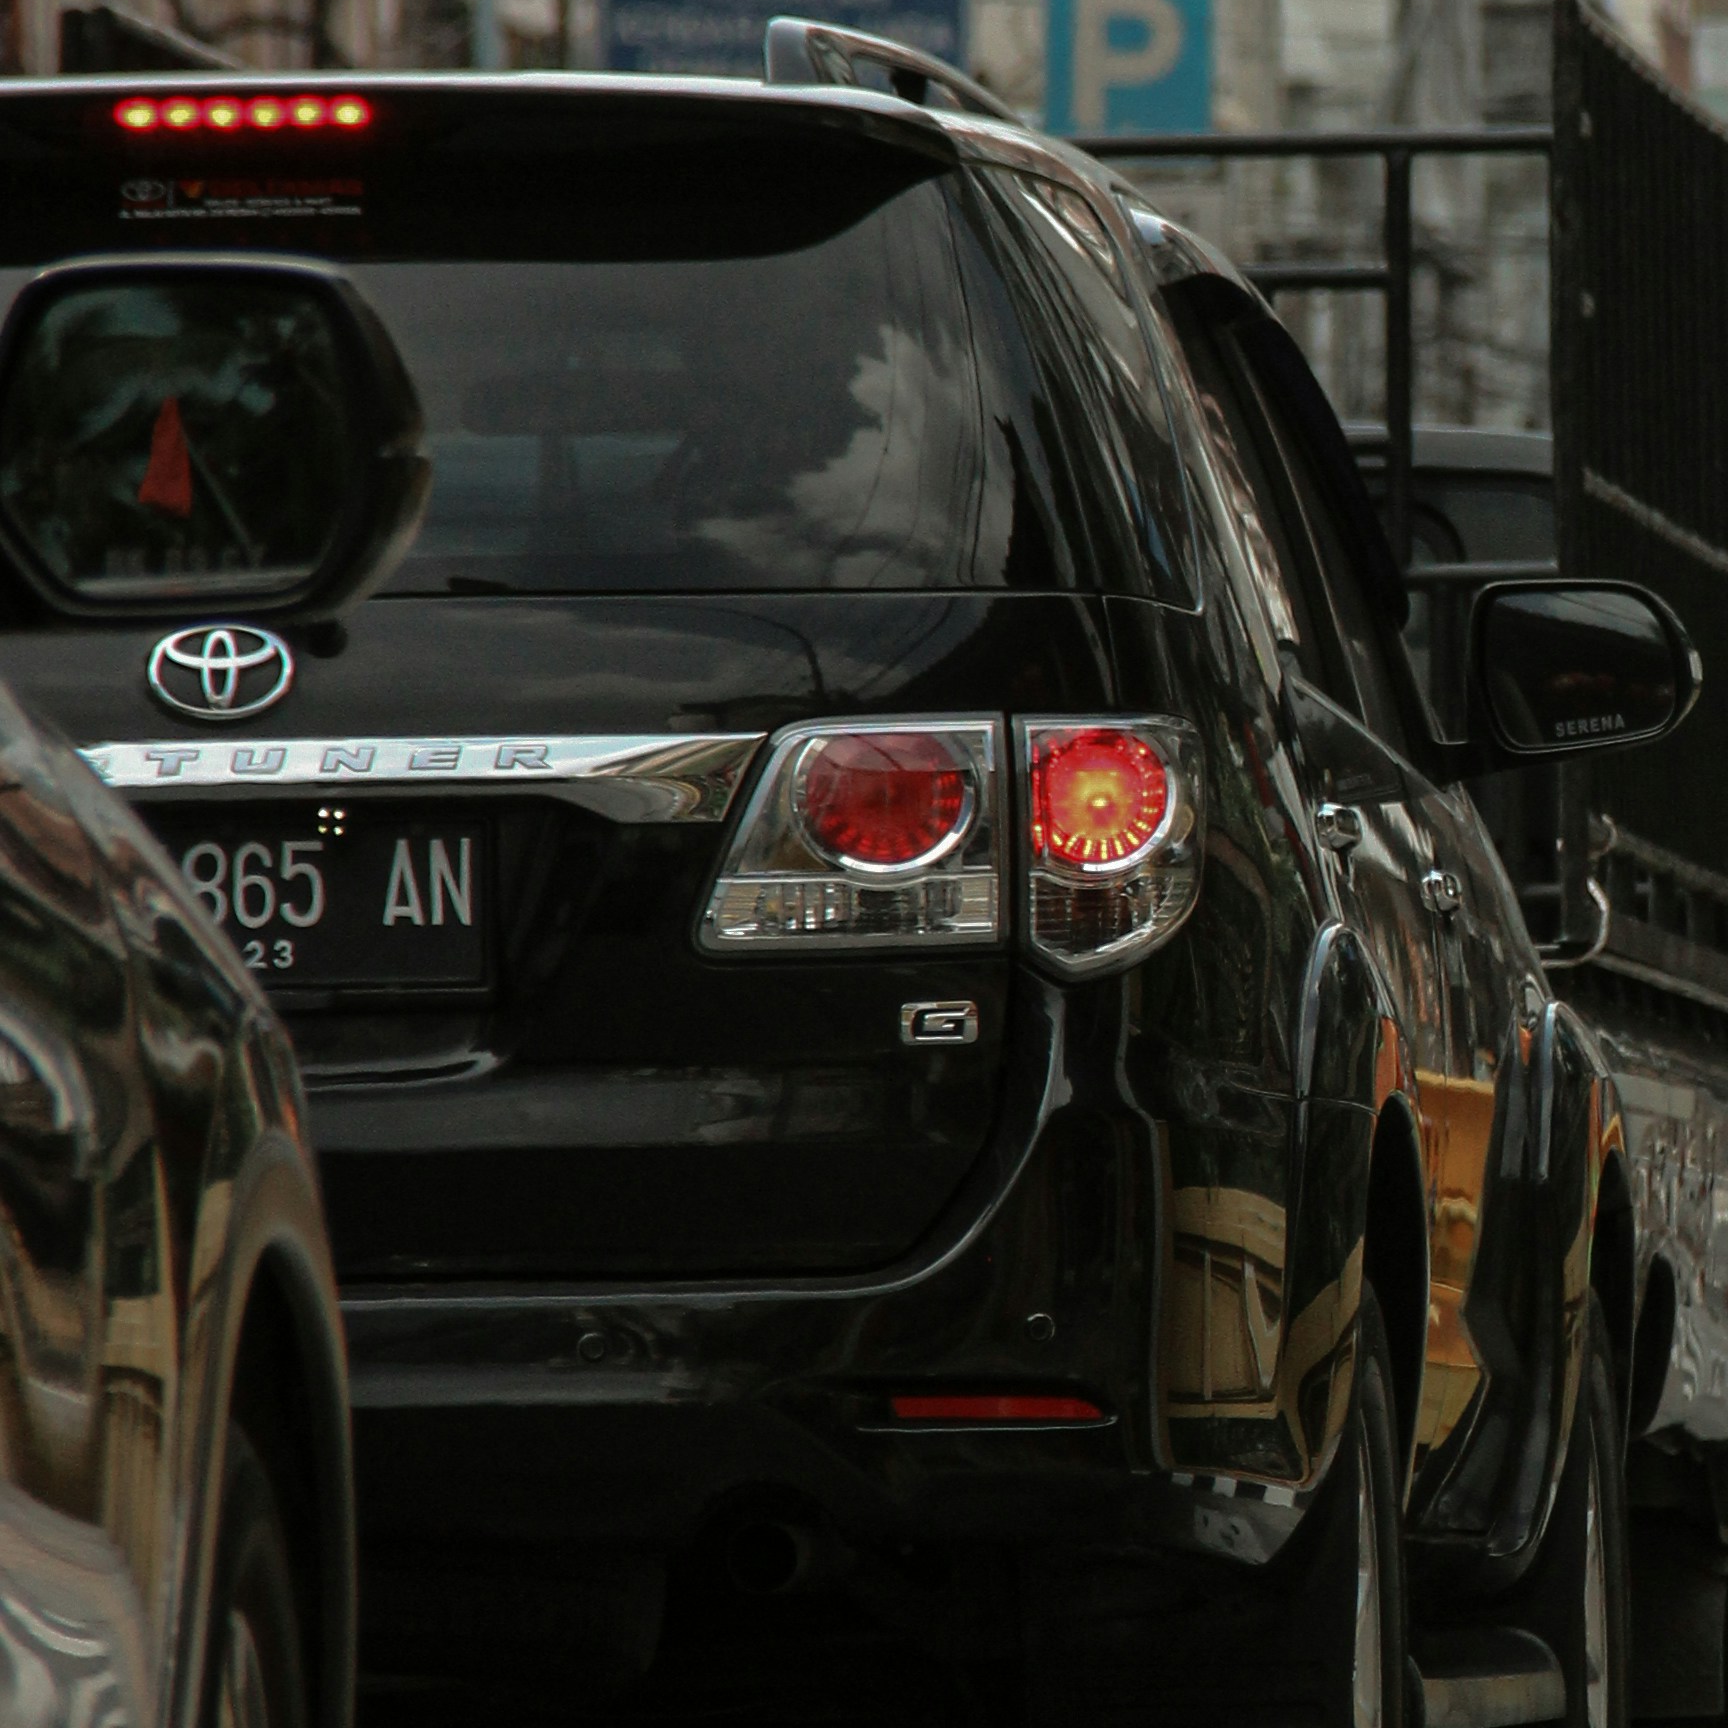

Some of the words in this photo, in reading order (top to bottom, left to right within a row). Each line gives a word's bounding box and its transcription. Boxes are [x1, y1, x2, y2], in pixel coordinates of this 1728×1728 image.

[1555, 713, 1625, 738] SERENA
[181, 840, 326, 929] 865
[382, 837, 472, 926] AN
[244, 939, 295, 970] 23
[901, 1000, 979, 1046] G
